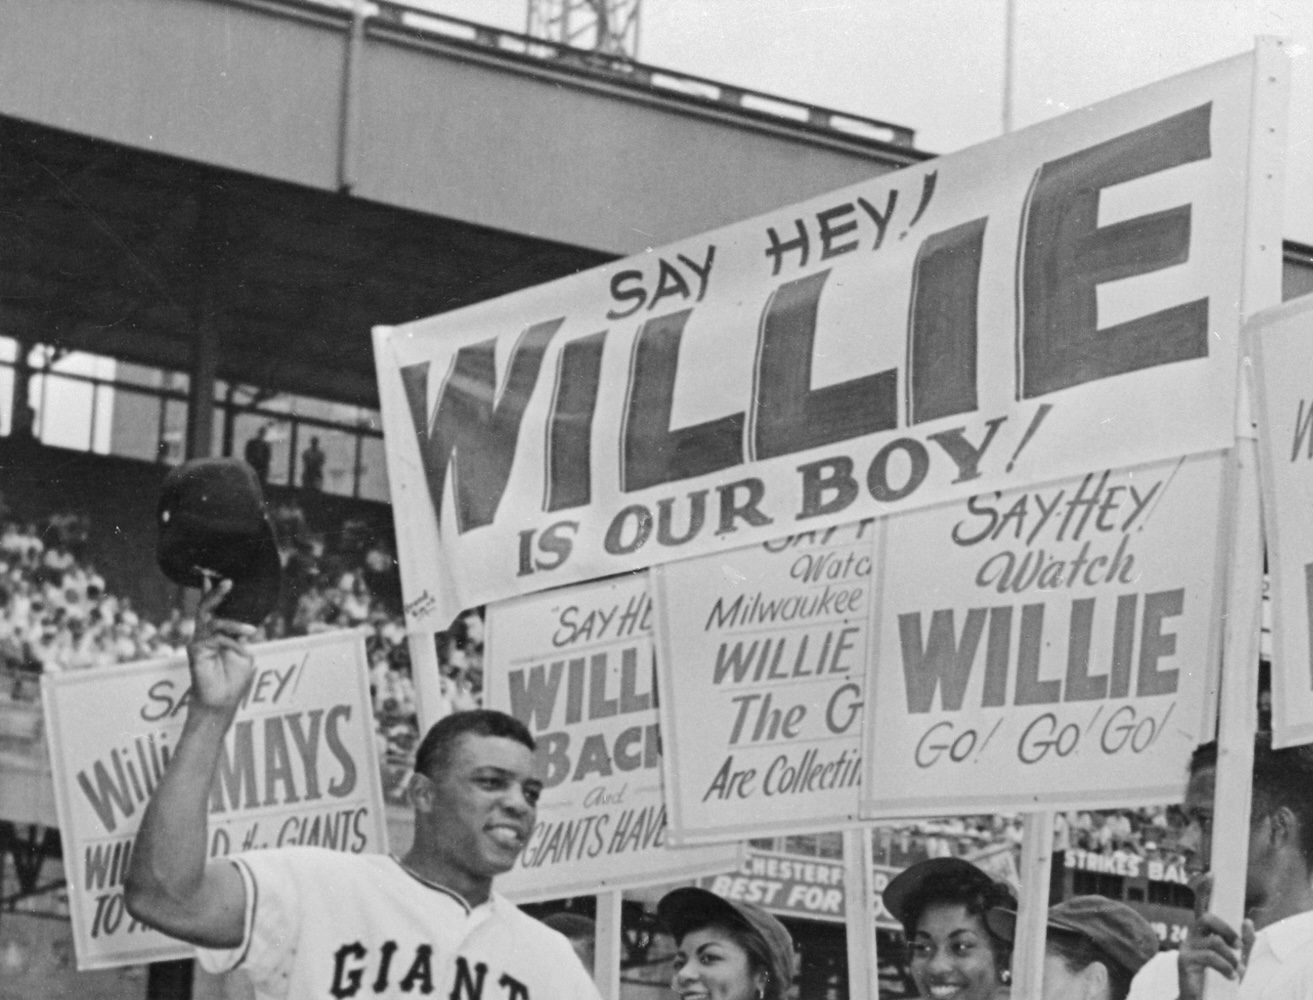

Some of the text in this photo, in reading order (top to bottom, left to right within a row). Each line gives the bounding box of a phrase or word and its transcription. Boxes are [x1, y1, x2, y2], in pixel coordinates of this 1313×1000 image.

[608, 169, 937, 320] SAY HEY!
[400, 100, 1213, 535] WILLIE
[516, 518, 581, 578] IS
[603, 473, 774, 556] OUR
[799, 404, 1053, 519] BOY!
[975, 534, 1135, 594] Watch
[704, 586, 863, 632] Milwaukee
[712, 627, 860, 685] WILLIE
[897, 588, 1186, 715] WILLIE
[728, 693, 807, 746] The
[210, 705, 357, 814] MAYS
[703, 755, 756, 802] Are
[1064, 850, 1144, 877] STRIKES
[711, 874, 783, 905] BEST
[786, 884, 843, 914] FOR
